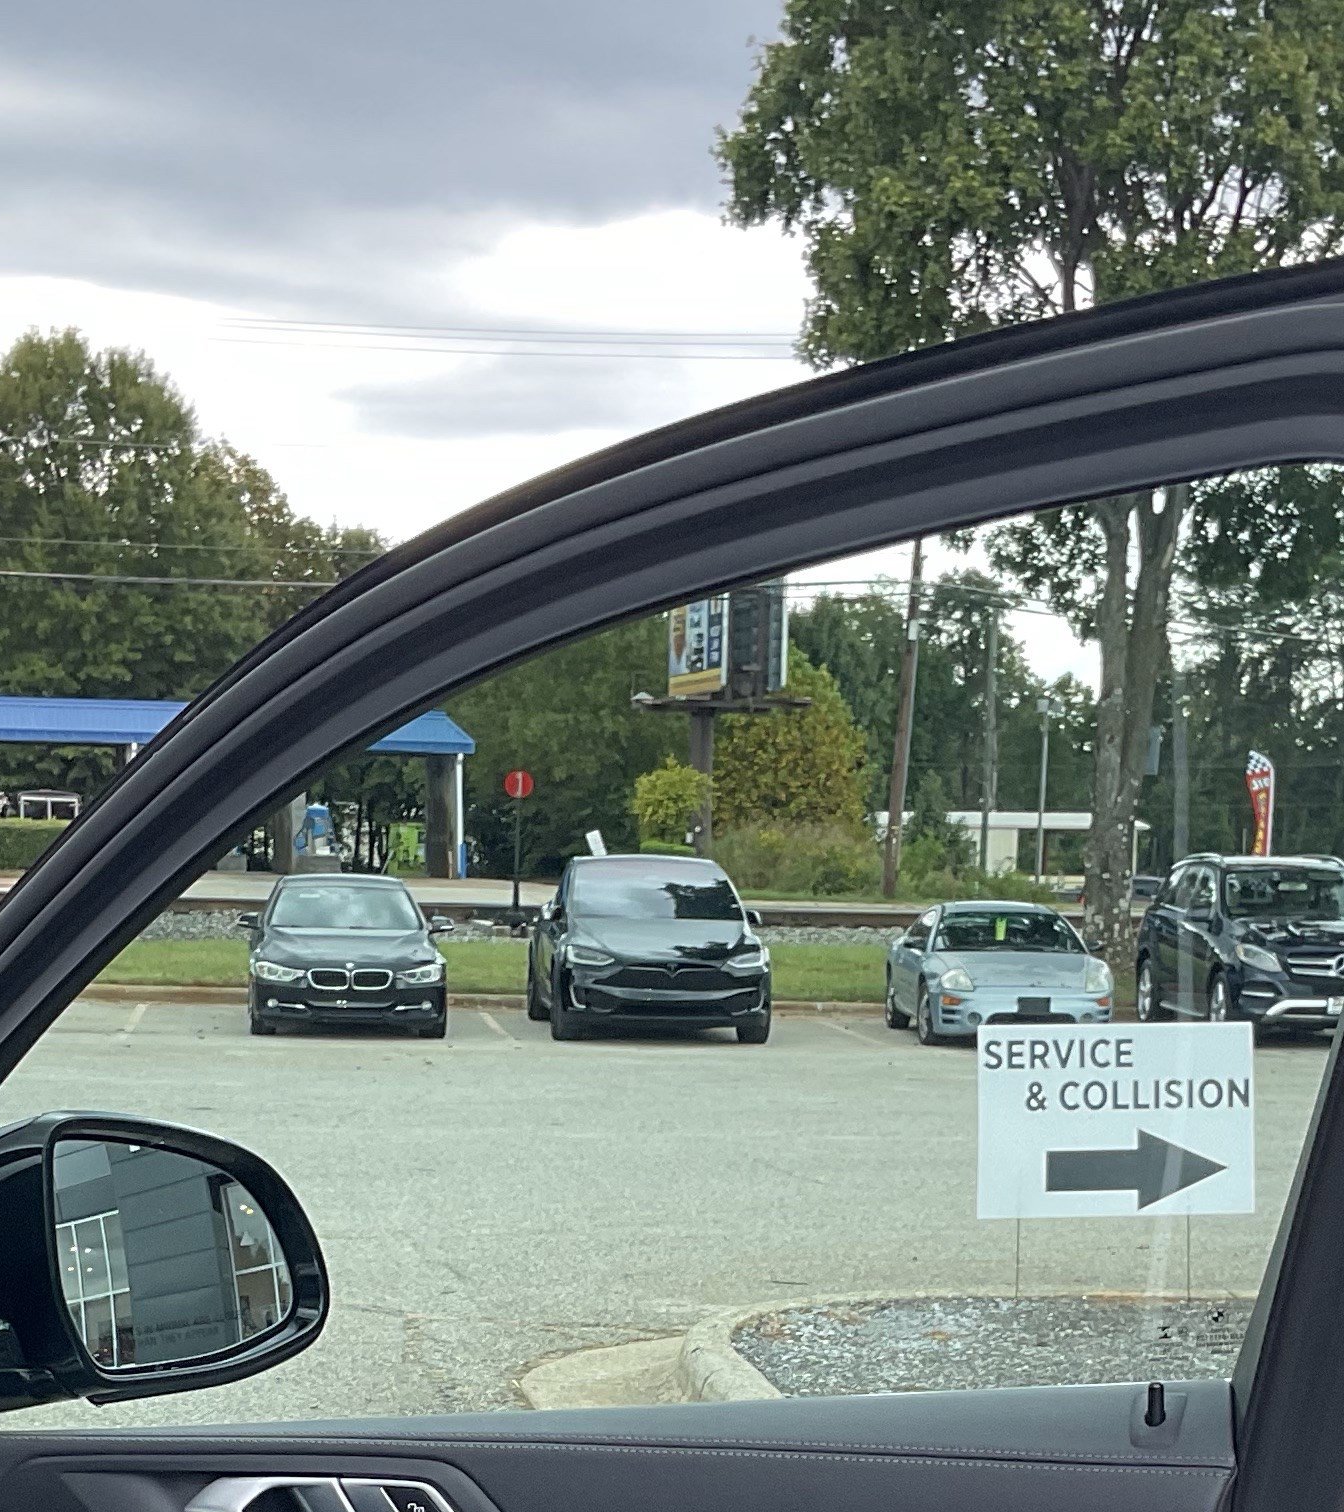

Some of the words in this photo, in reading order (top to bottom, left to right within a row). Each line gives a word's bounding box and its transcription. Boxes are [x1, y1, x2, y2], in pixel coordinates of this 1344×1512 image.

[983, 1038, 1134, 1070] SERVICE
[1025, 1081, 1047, 1112] &
[1058, 1078, 1251, 1112] COLLISION
